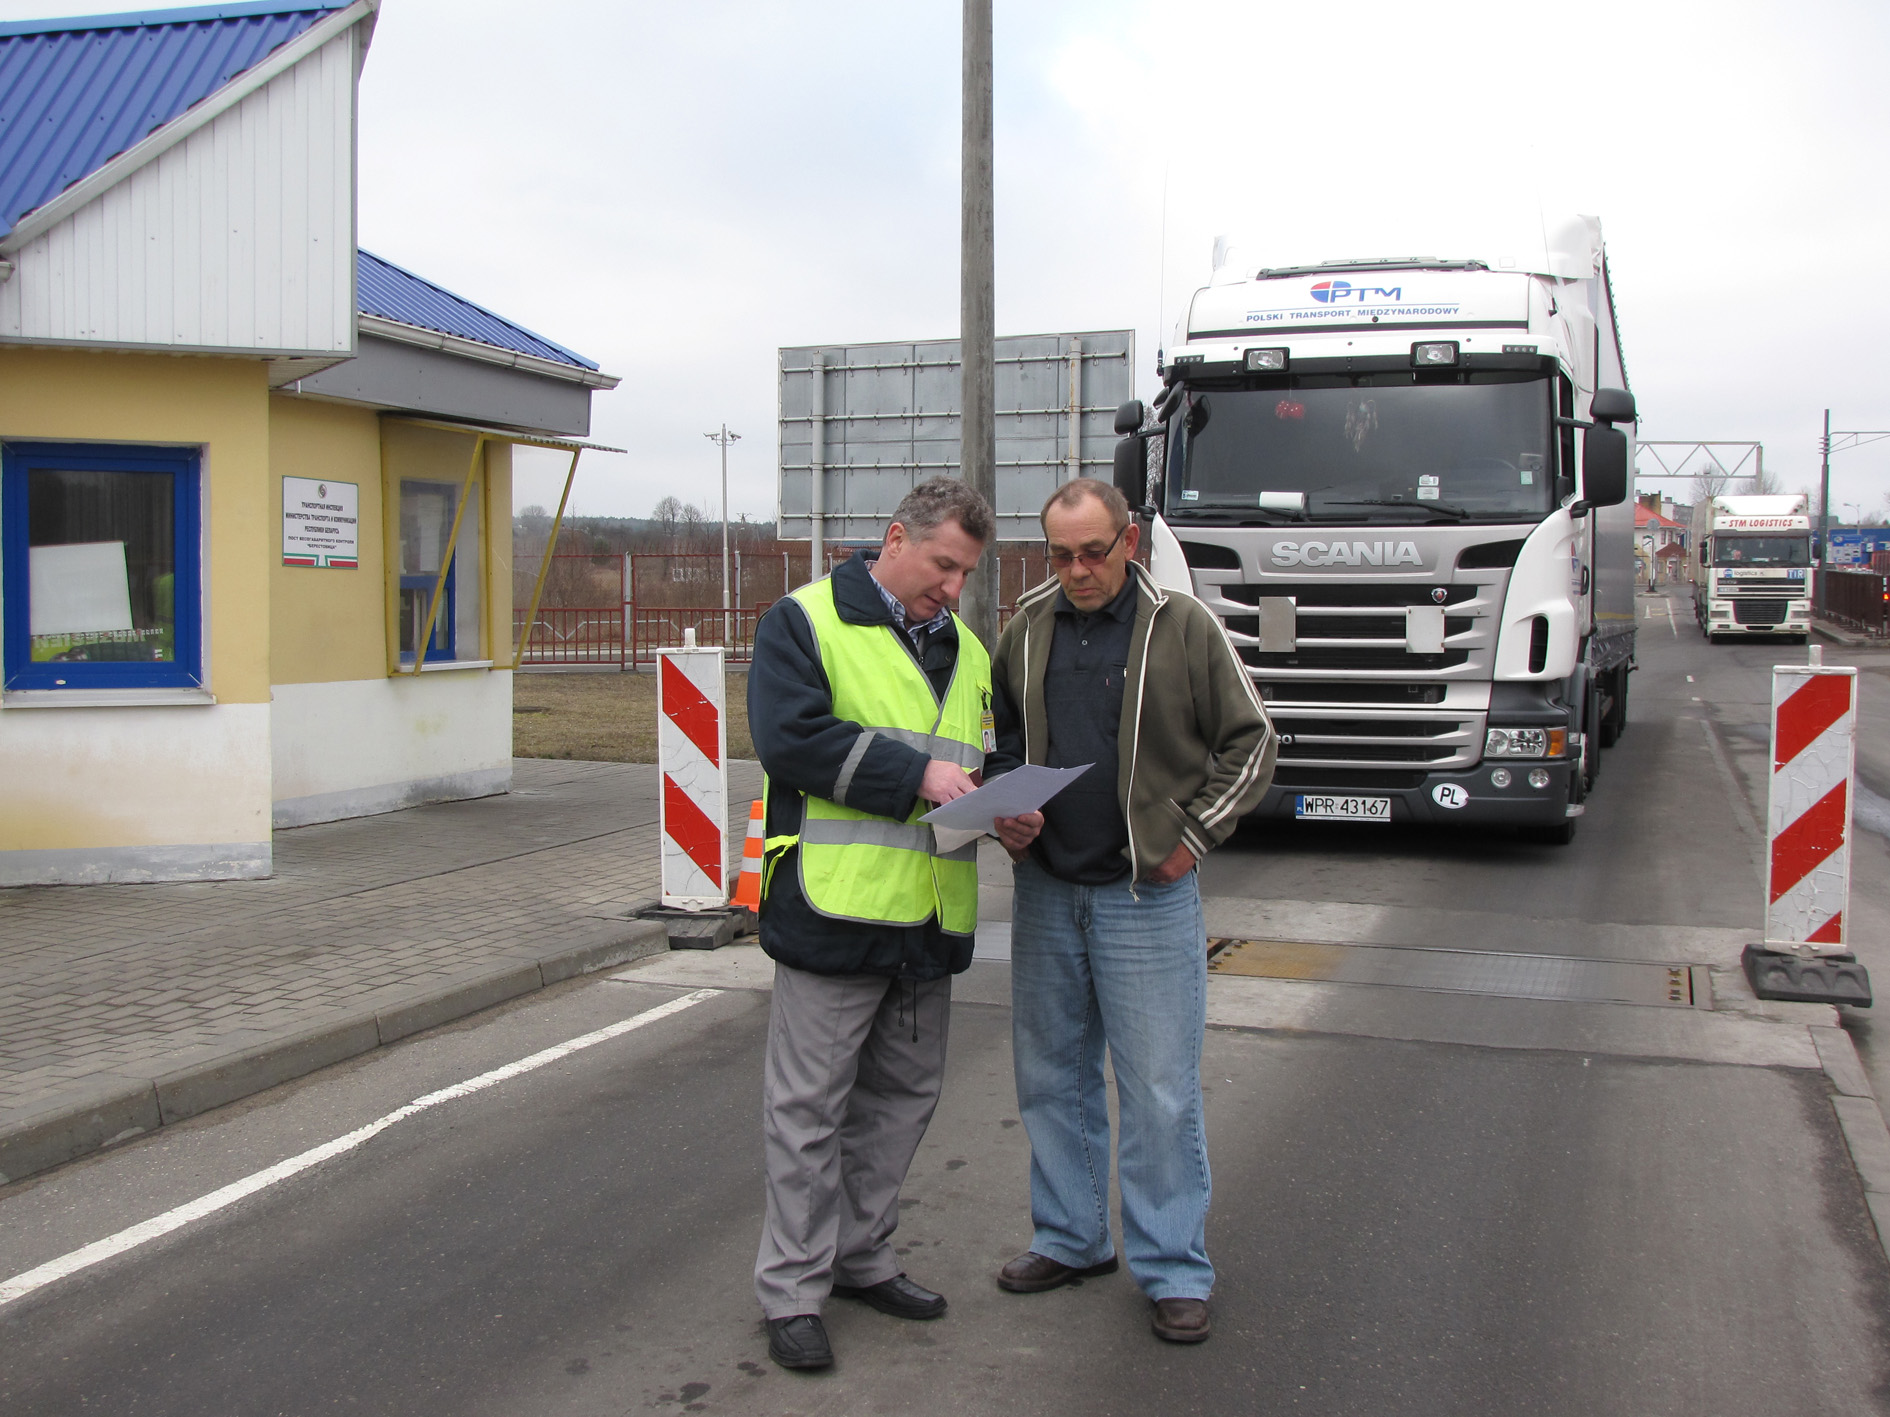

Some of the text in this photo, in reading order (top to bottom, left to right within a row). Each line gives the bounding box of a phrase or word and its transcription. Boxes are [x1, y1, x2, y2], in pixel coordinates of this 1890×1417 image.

[1329, 281, 1402, 303] PTM
[1246, 312, 1283, 322] POLSKI
[1290, 309, 1351, 320] TRANSPORT
[1729, 519, 1793, 527] STM LOGISTICS
[1271, 541, 1423, 567] SCANIA
[1788, 569, 1805, 579] TIR
[1439, 786, 1460, 806] PL
[1304, 797, 1335, 814] WPR
[1340, 798, 1389, 815] 43167
